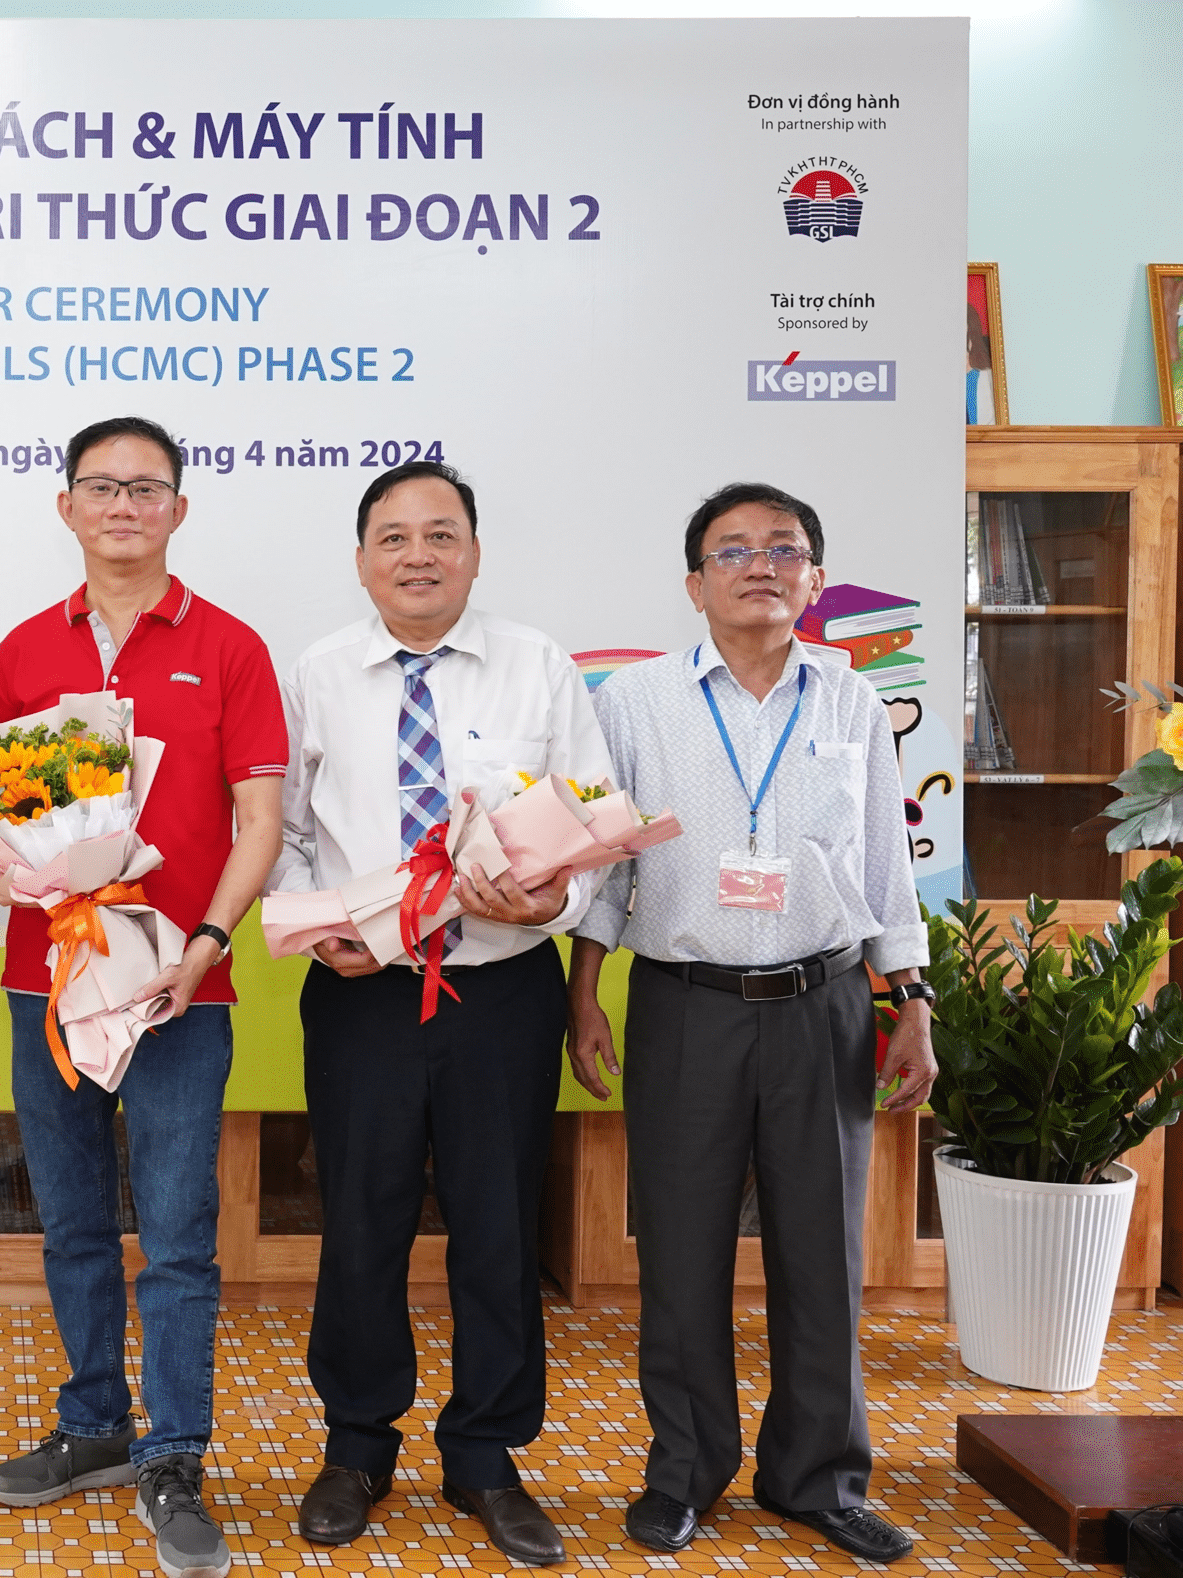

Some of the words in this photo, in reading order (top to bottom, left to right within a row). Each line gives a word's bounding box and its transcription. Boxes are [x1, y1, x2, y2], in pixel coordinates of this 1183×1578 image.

[748, 95, 783, 109] Đơn
[788, 95, 802, 112] vị
[808, 92, 851, 112] đồng
[858, 94, 899, 108] hành
[133, 112, 176, 159] &
[193, 102, 325, 159] MÁY
[338, 102, 482, 159] TÍNH
[762, 119, 773, 129] In
[778, 118, 854, 132] partnership
[858, 118, 886, 129] with
[777, 155, 869, 196] TVKHTHTPHCM
[37, 183, 208, 240] THỨC
[225, 193, 348, 240] GIAI
[366, 194, 548, 255] ĐOẠN
[568, 195, 600, 240] 2
[808, 225, 835, 241] GSL
[26, 287, 269, 322] CEREMONY
[770, 293, 793, 307] Tài
[799, 295, 824, 311] trợ
[828, 293, 874, 308] chính
[778, 317, 847, 331] Sponsored
[853, 317, 868, 331] by
[65, 346, 222, 387] (HCMC)
[239, 347, 378, 382] PHASE
[392, 348, 414, 381] 2
[756, 351, 888, 399] Keppel
[245, 440, 265, 467] 4
[276, 439, 349, 467] năm
[360, 440, 445, 467] 2024
